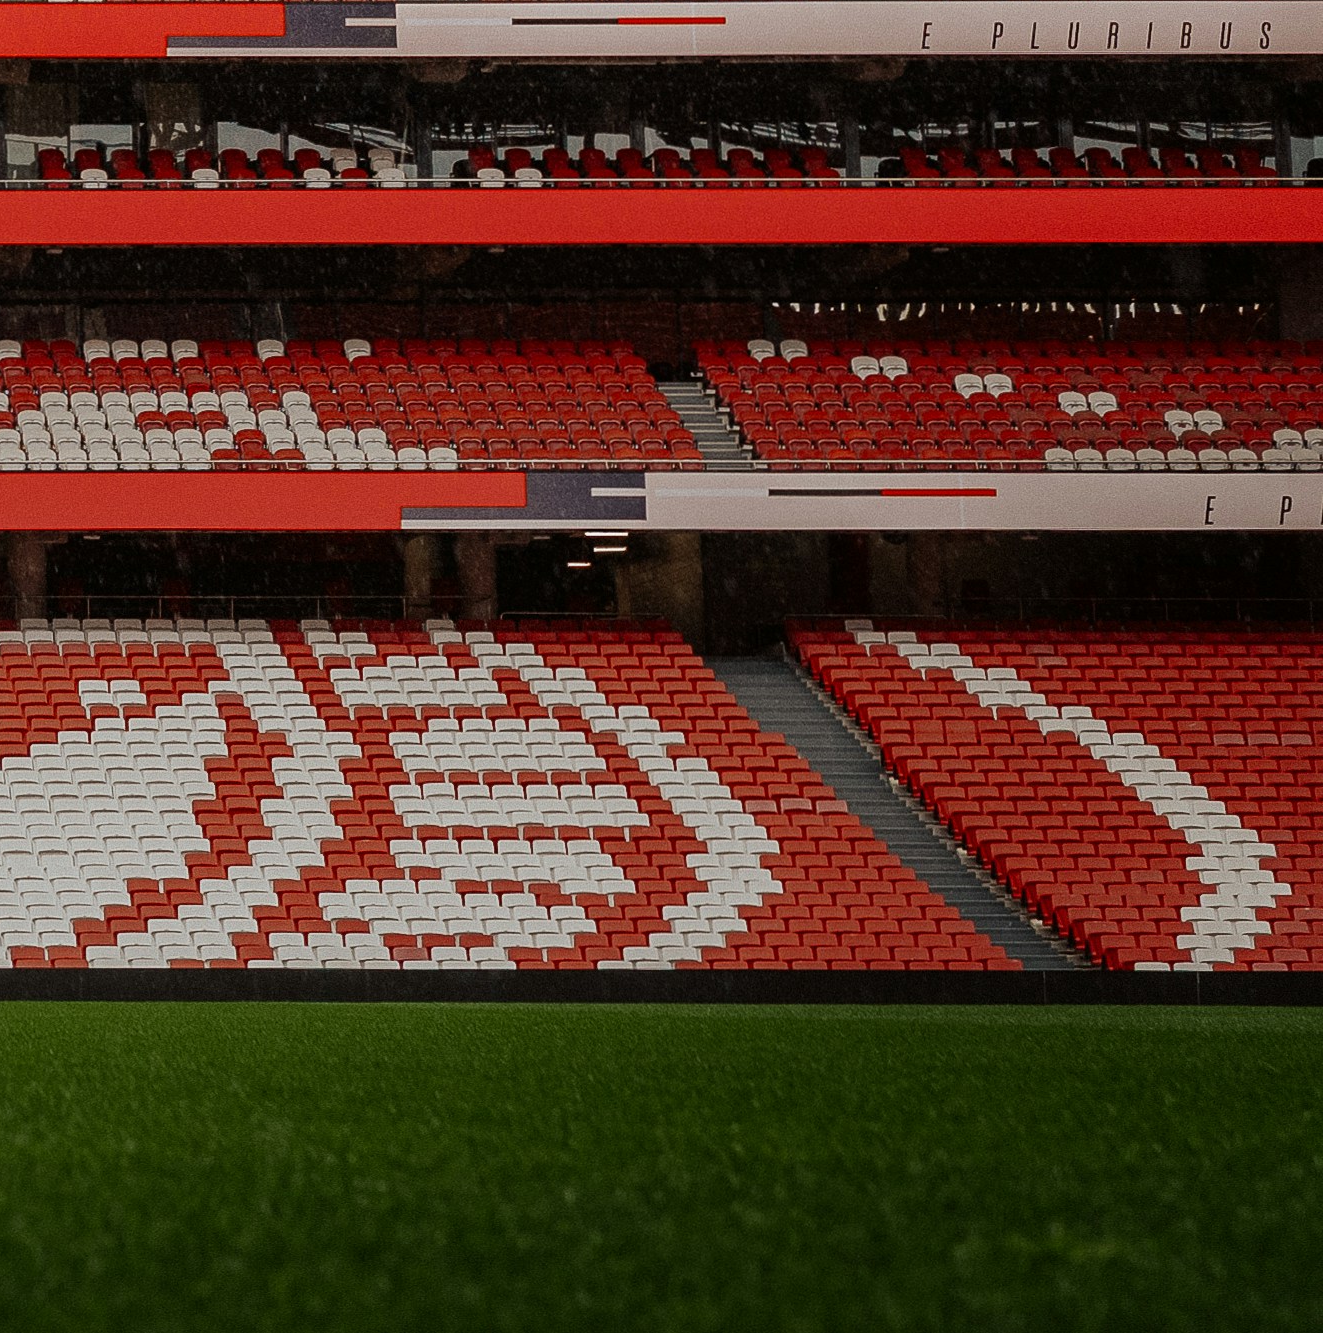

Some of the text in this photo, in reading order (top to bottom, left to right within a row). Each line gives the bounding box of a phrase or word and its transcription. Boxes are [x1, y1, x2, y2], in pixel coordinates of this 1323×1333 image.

[921, 21, 1272, 50] E PLURIBUS
[1204, 495, 1217, 526] E
